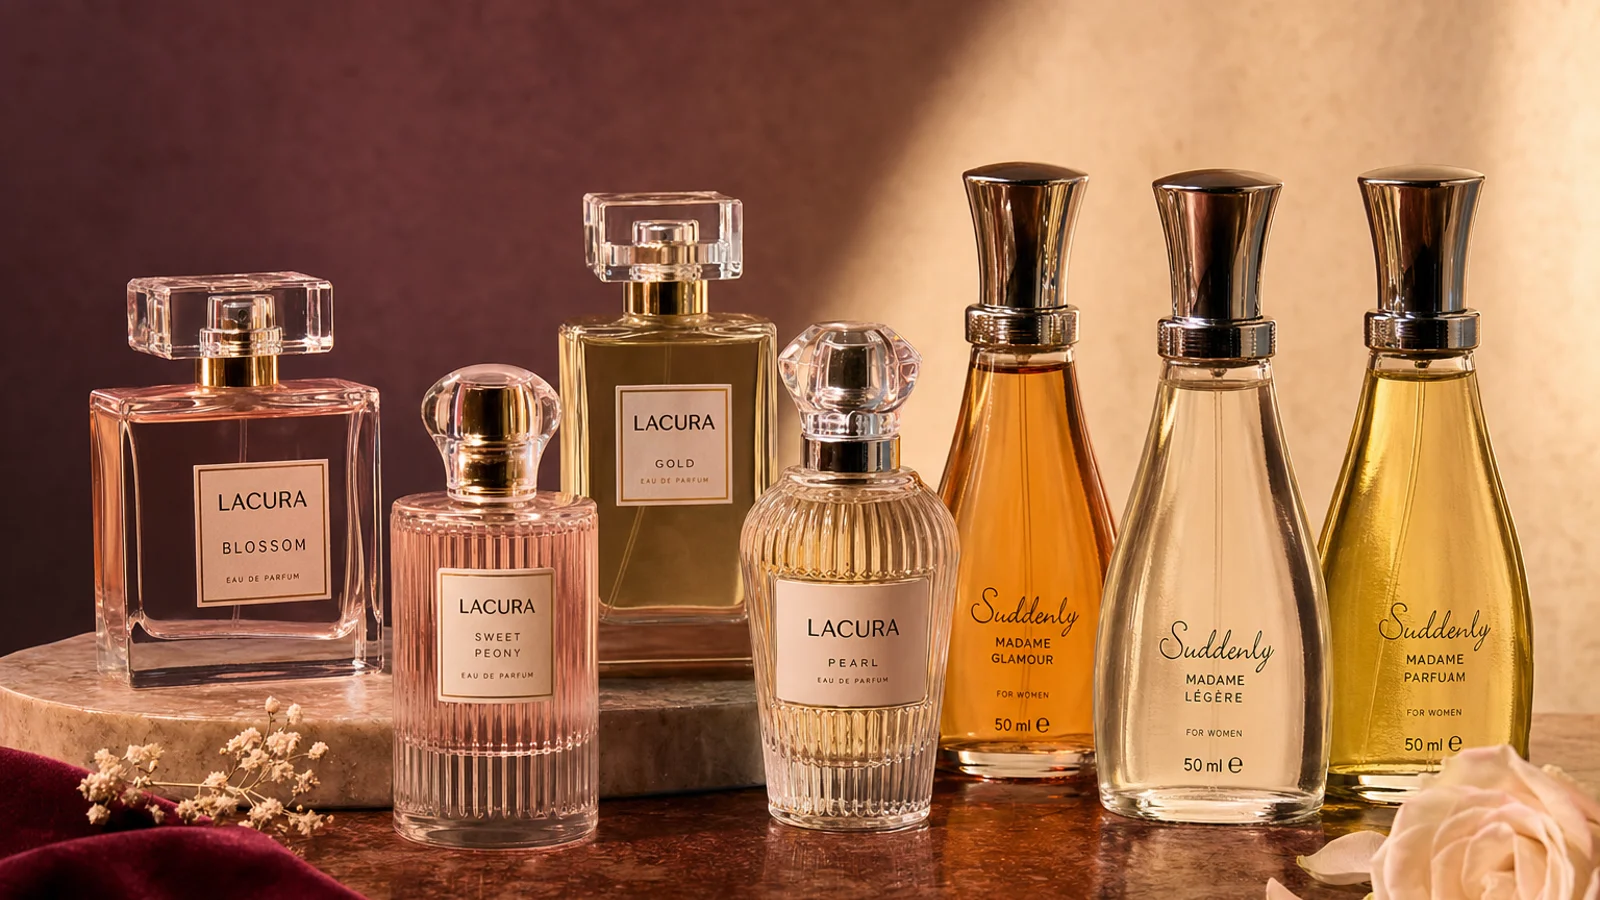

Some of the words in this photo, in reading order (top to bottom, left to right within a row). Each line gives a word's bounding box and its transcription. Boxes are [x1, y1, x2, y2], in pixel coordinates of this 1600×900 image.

[634, 414, 715, 431] LACURA
[655, 459, 695, 468] GOLD
[218, 490, 307, 511] LACURA
[222, 538, 306, 554] BLOSSOM
[264, 573, 300, 581] PARFUM
[460, 598, 535, 614] LACURA
[971, 587, 1079, 637] Suddenly
[808, 618, 900, 638] LACURA
[1379, 602, 1491, 651] Suddenly
[475, 632, 521, 641] SWEET
[995, 637, 1051, 649] MADAME
[1159, 620, 1275, 673] Suddenly
[475, 648, 521, 658] PEONY
[991, 653, 1054, 665] GLAMOUR
[829, 658, 878, 668] PEARL
[1406, 654, 1464, 665] MADAME
[1186, 674, 1245, 686] MADAME
[1404, 672, 1466, 683] PARFUAM
[997, 690, 1013, 698] FOR
[1017, 691, 1049, 699] WOMEN
[1185, 689, 1243, 703] LÉGÈRE
[995, 718, 1012, 731] 50
[1016, 719, 1031, 732] ml
[1186, 729, 1204, 737] FOR
[1207, 729, 1243, 737] WOMEN
[1405, 738, 1423, 751] 50
[1427, 738, 1443, 751] ml
[1184, 758, 1202, 772] 50
[1206, 759, 1222, 773] ml
